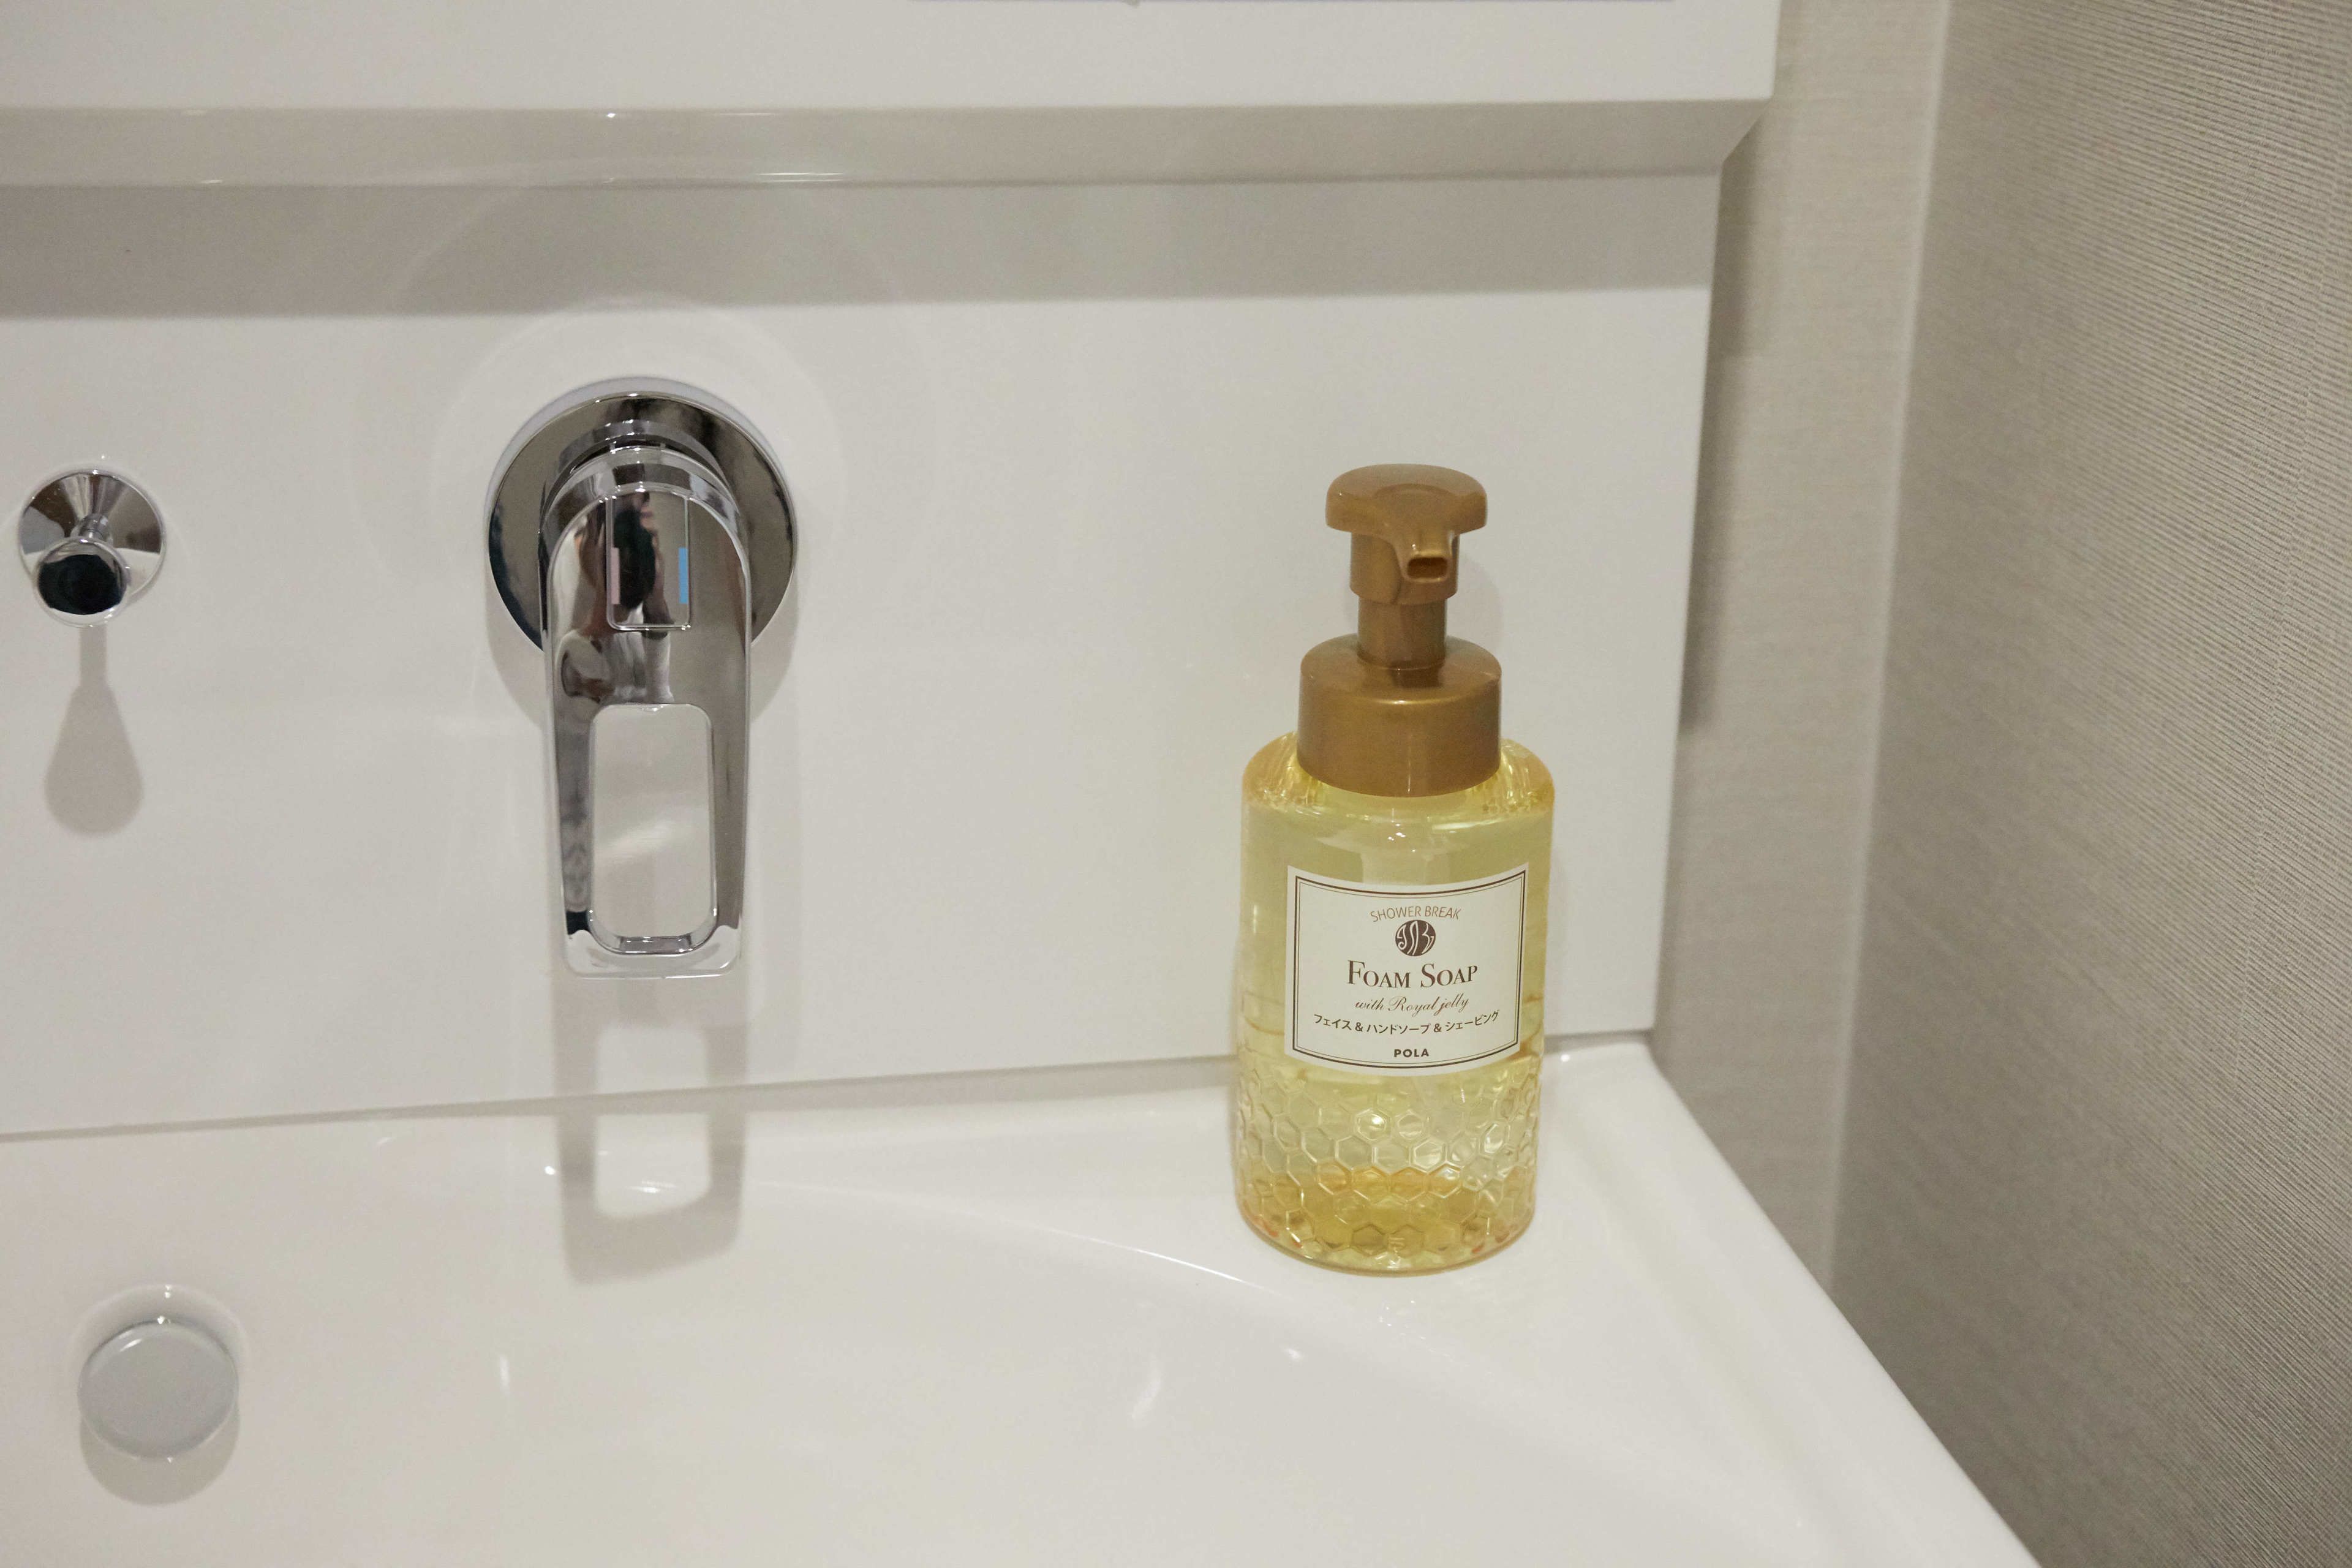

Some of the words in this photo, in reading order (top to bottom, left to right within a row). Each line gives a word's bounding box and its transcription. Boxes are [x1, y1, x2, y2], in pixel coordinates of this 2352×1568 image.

[1370, 906, 1421, 922] SHOWER
[1425, 906, 1461, 919] BREAK
[1348, 960, 1411, 988] FOAM
[1420, 963, 1477, 987] SOAP
[1355, 997, 1384, 1011] with
[1387, 996, 1437, 1017] Royal
[1436, 993, 1469, 1016] jelly
[1393, 1049, 1429, 1057] POLA
